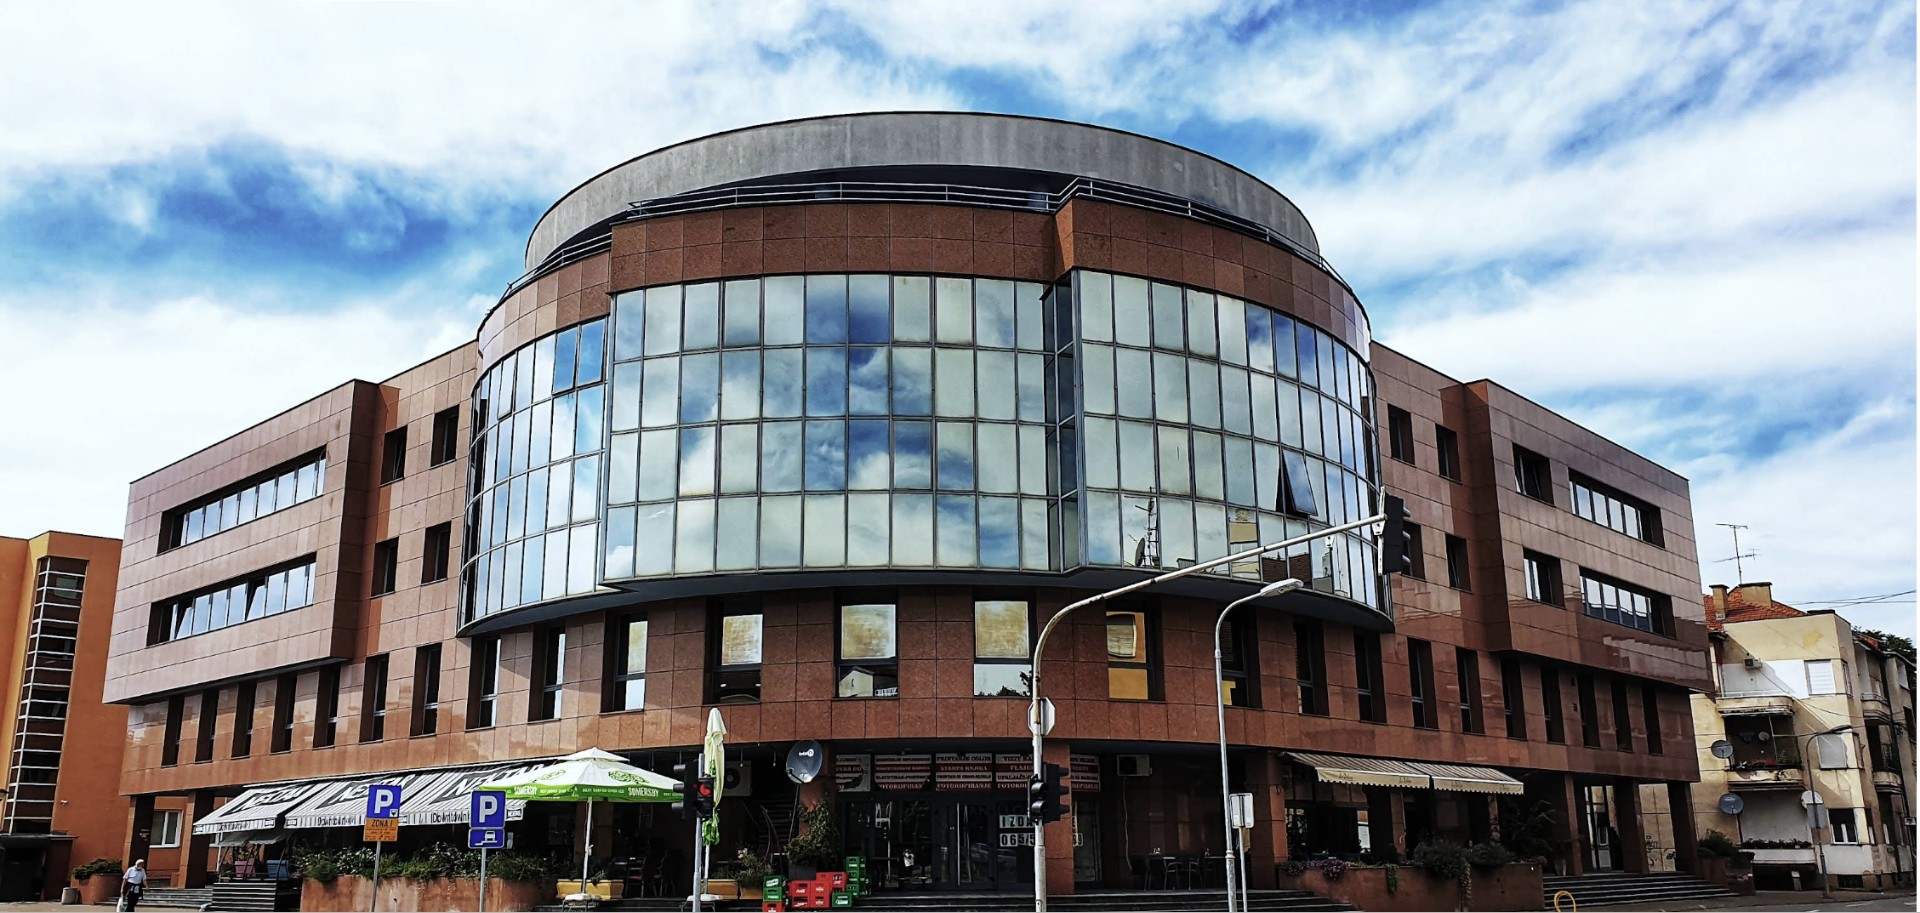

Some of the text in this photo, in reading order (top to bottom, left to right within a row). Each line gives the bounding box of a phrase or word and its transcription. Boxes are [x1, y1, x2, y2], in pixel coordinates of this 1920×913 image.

[627, 787, 659, 797] SOMERSBY
[374, 789, 394, 814] P
[479, 796, 498, 823] P
[371, 820, 388, 828] ZONA
